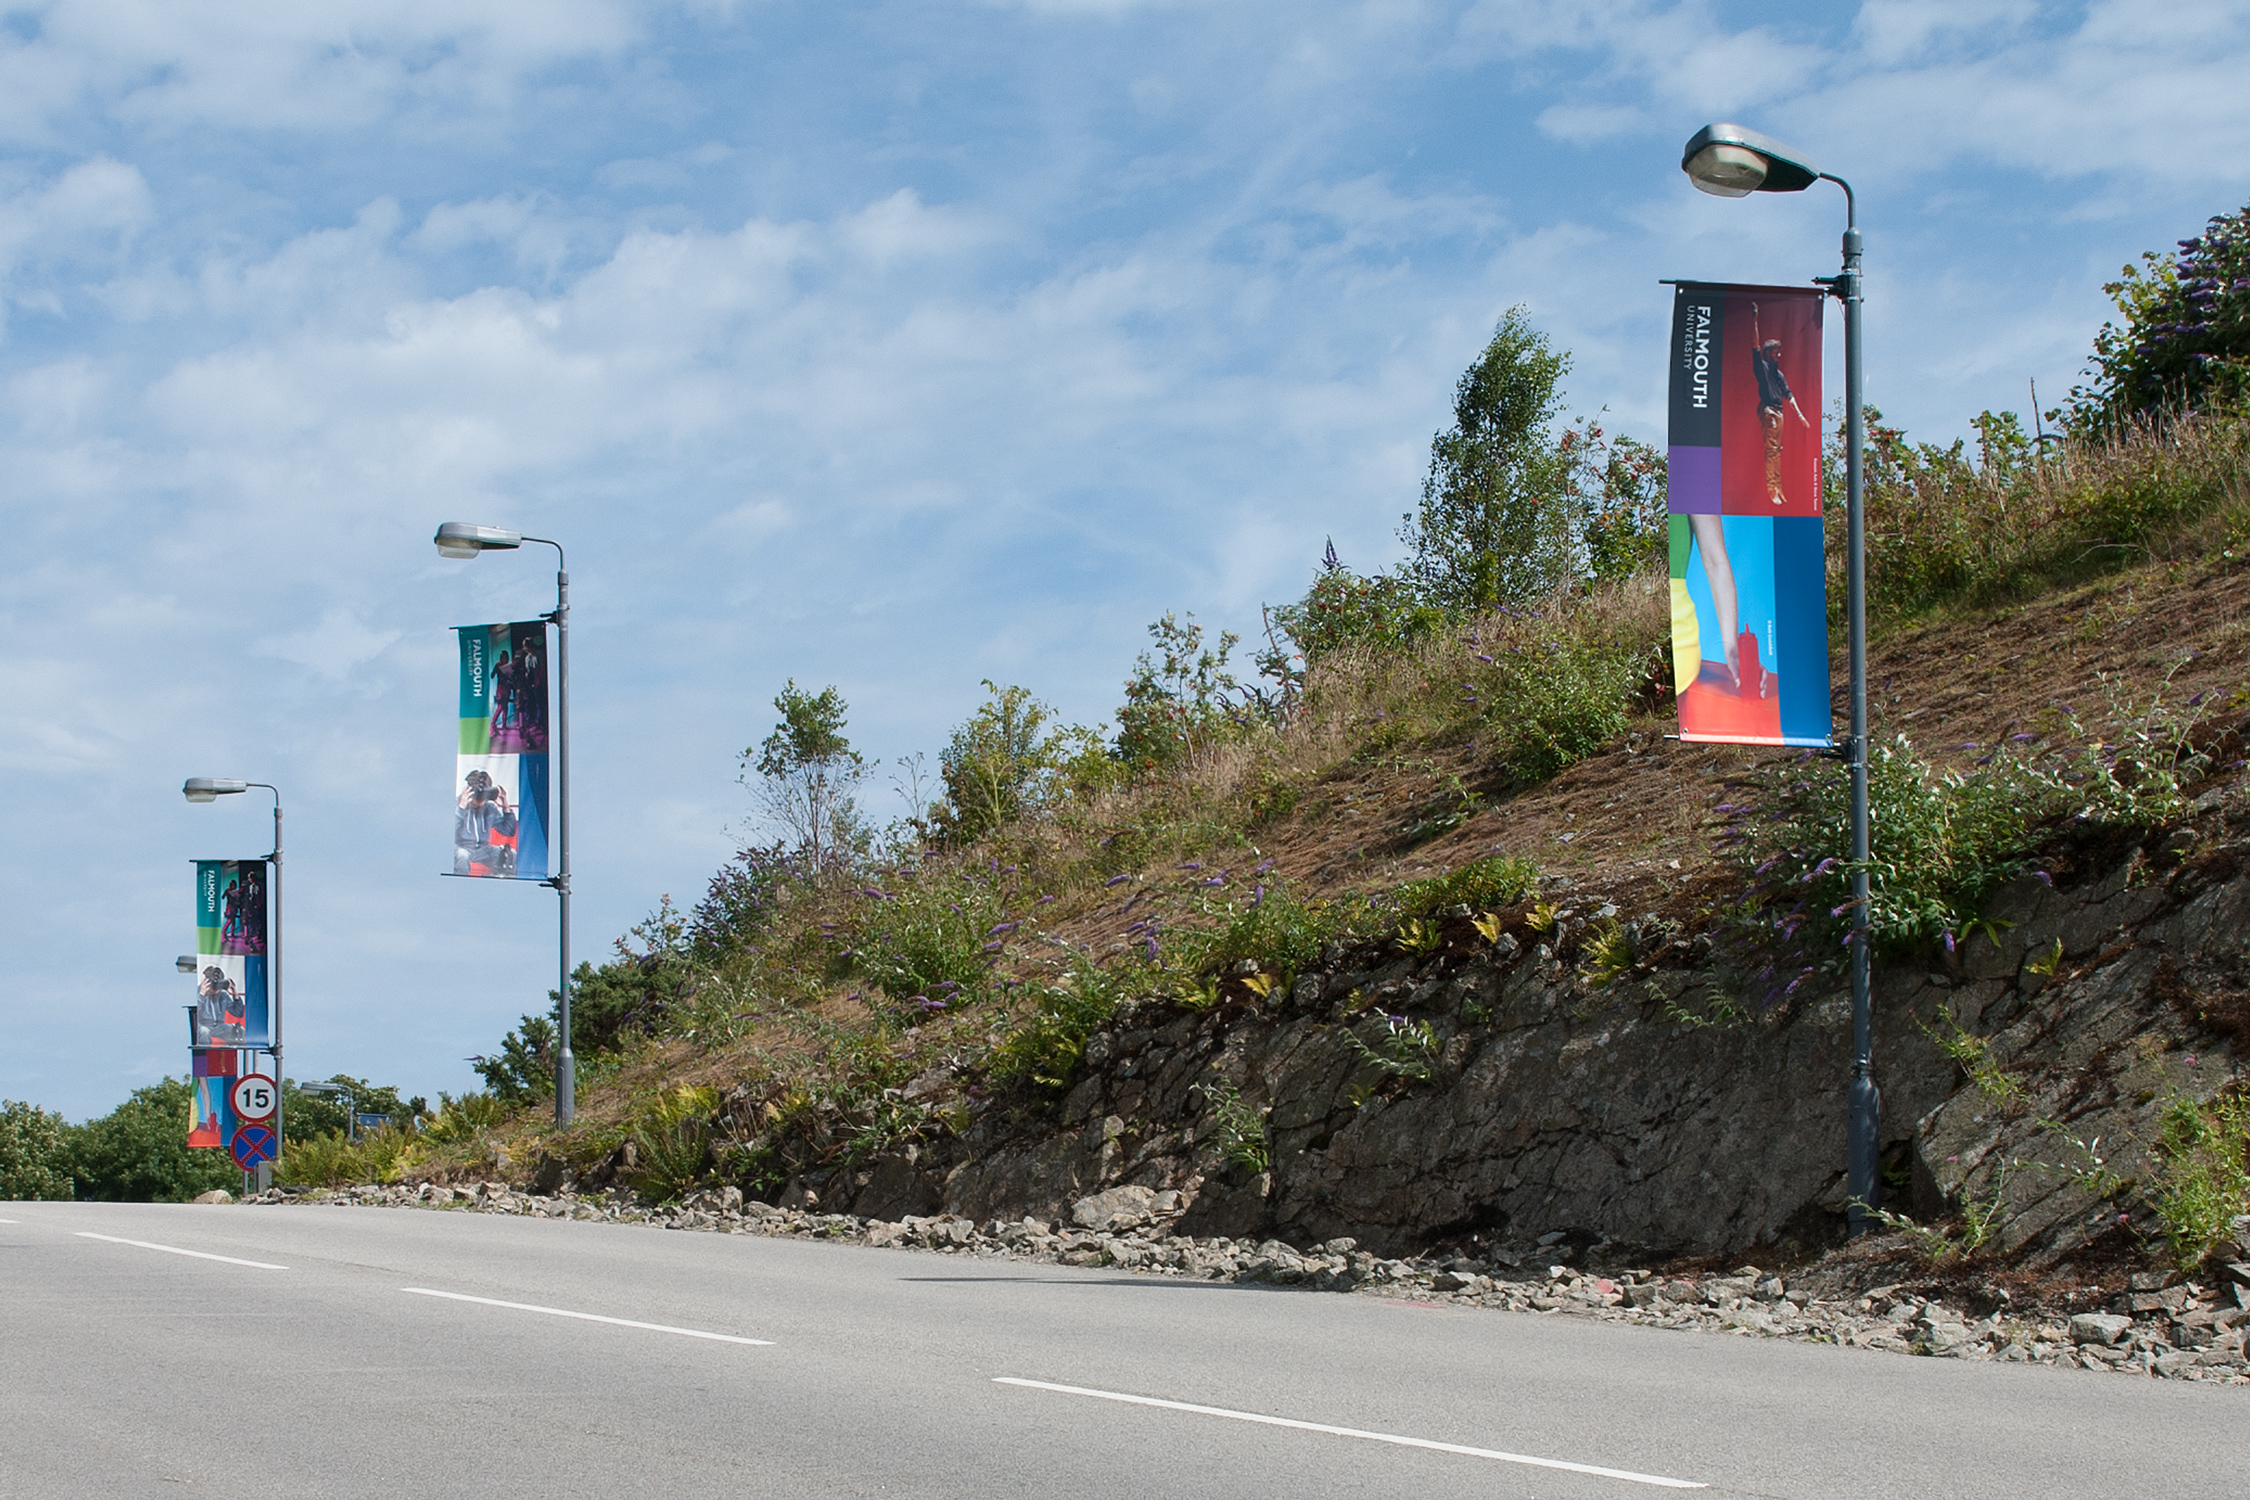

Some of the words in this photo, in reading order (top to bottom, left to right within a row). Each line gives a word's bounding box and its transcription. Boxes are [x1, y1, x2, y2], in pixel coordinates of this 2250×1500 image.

[1683, 305, 1696, 370] UNIVERSITY
[1693, 306, 1711, 408] FALMOUTH
[473, 639, 483, 697] FALMOUTH
[207, 870, 216, 912] FALMOUTH
[243, 1088, 270, 1108] 15
